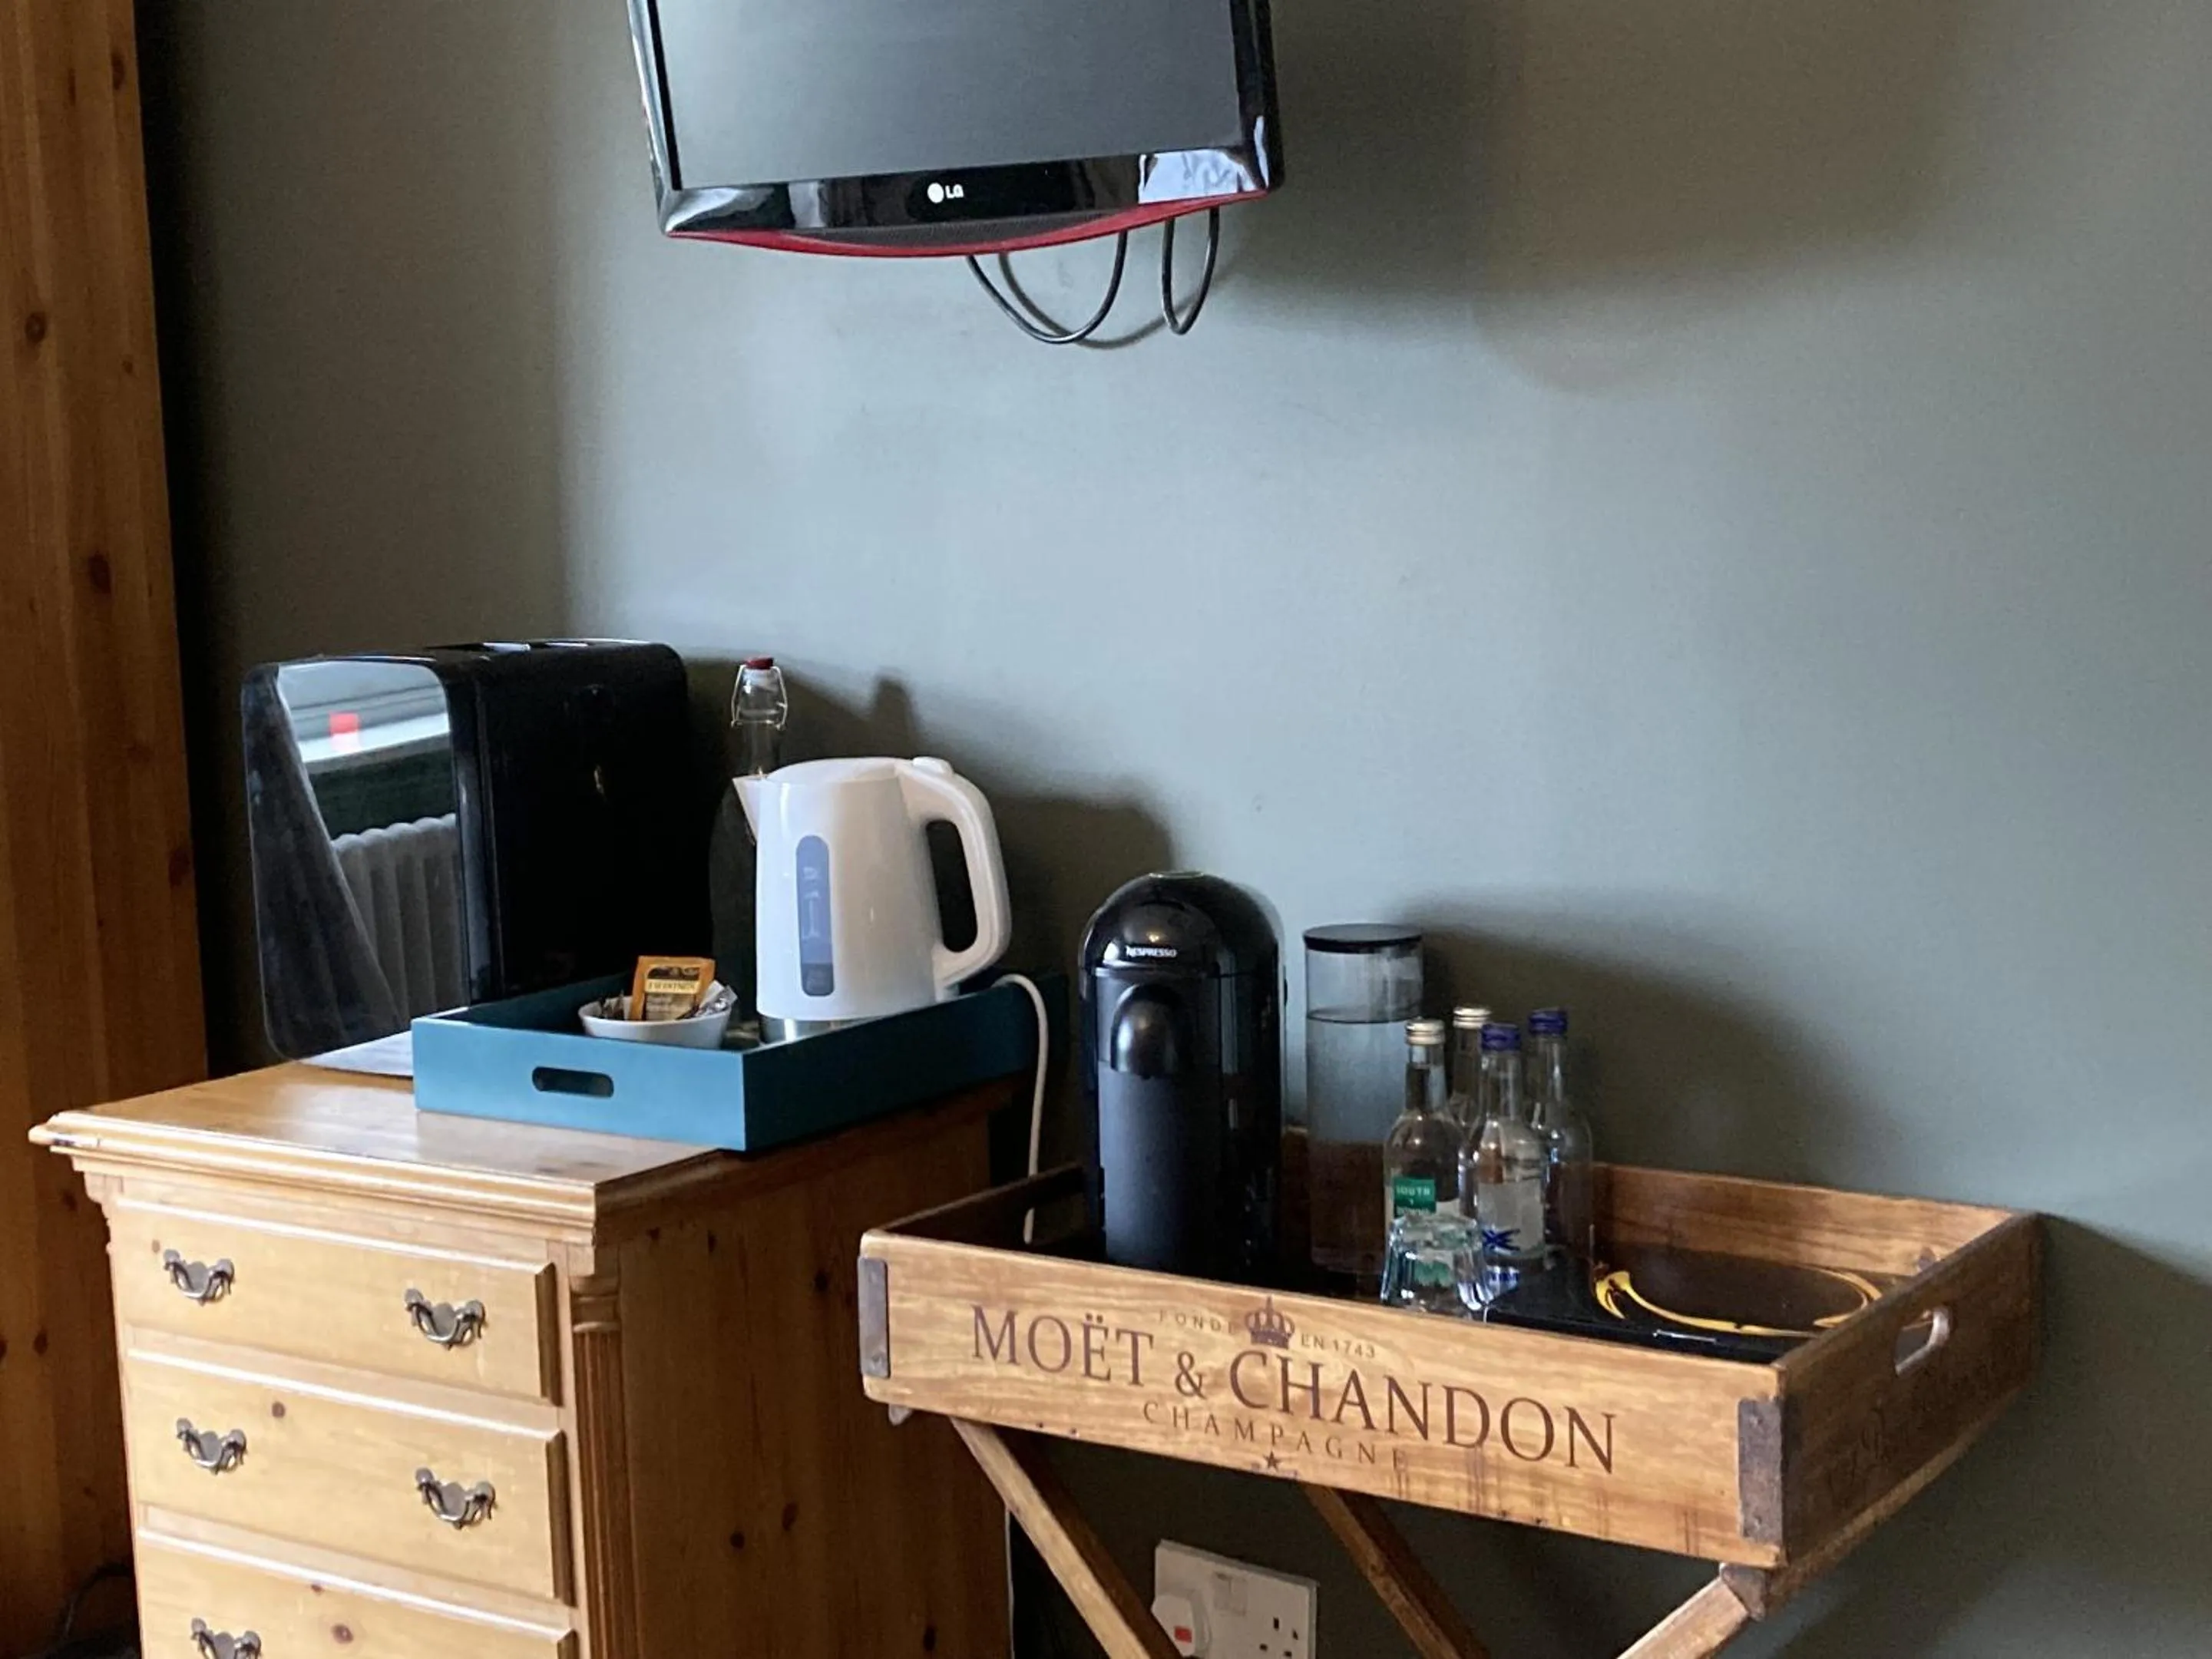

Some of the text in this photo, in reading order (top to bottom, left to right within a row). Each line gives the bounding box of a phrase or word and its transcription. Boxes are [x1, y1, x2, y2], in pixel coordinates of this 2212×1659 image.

[944, 184, 964, 198] LG
[1333, 1338, 1376, 1358] 1743
[970, 1304, 1617, 1474] MOËT & CHANDON
[1142, 1401, 1406, 1472] CHAMPAGNE
